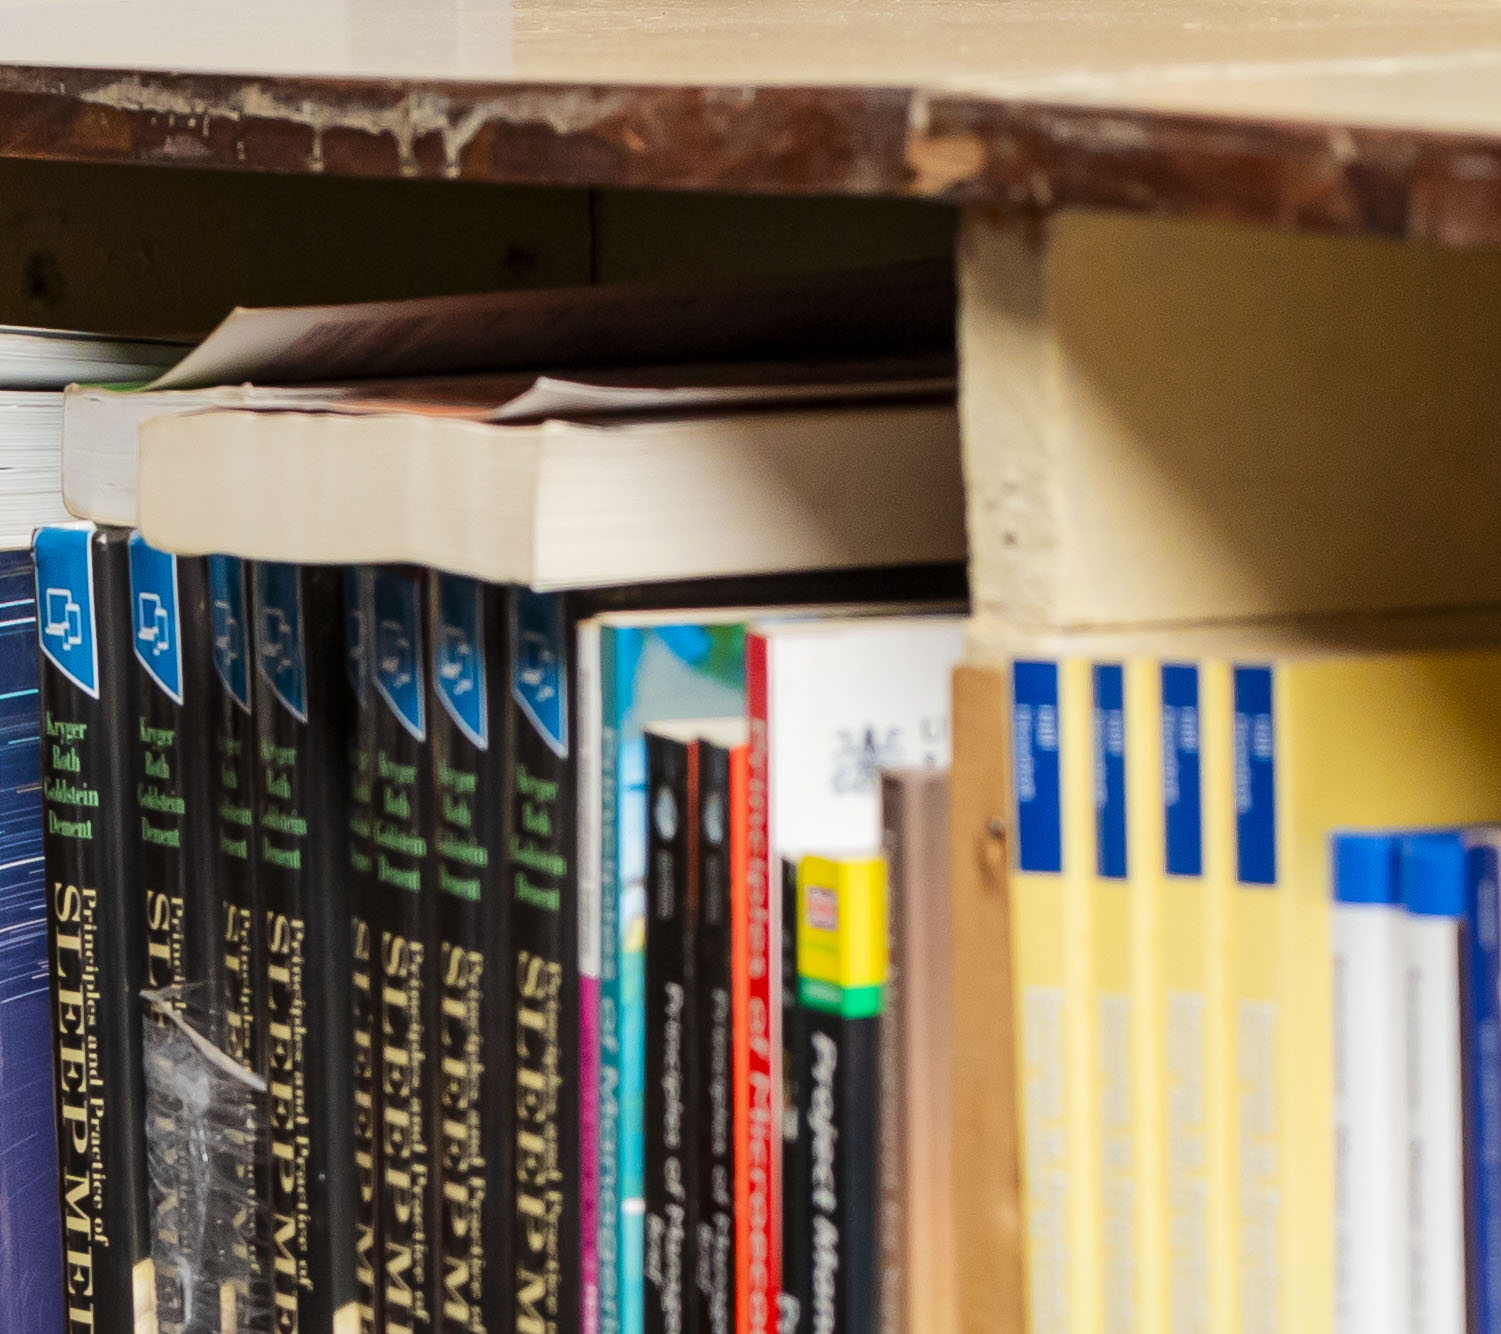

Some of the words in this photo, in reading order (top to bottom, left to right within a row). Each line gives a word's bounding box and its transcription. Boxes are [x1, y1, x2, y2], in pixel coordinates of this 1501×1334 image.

[46, 712, 87, 741] Kryger
[52, 744, 81, 773] Roth
[49, 809, 93, 840] Dement
[53, 882, 91, 1154] SLEEP
[82, 887, 100, 1029] Principles
[91, 1098, 106, 1211] Practice
[266, 911, 294, 1194] SLEEP
[291, 919, 306, 1062] Principles
[663, 982, 684, 1149] Principles
[710, 987, 729, 1155] Principles
[382, 932, 412, 1223] SLEEP
[440, 941, 470, 1238] SLEEP
[516, 951, 547, 1253] SLEEP
[807, 1033, 837, 1212] Project
[664, 1157, 684, 1199] of
[712, 1166, 729, 1206] of
